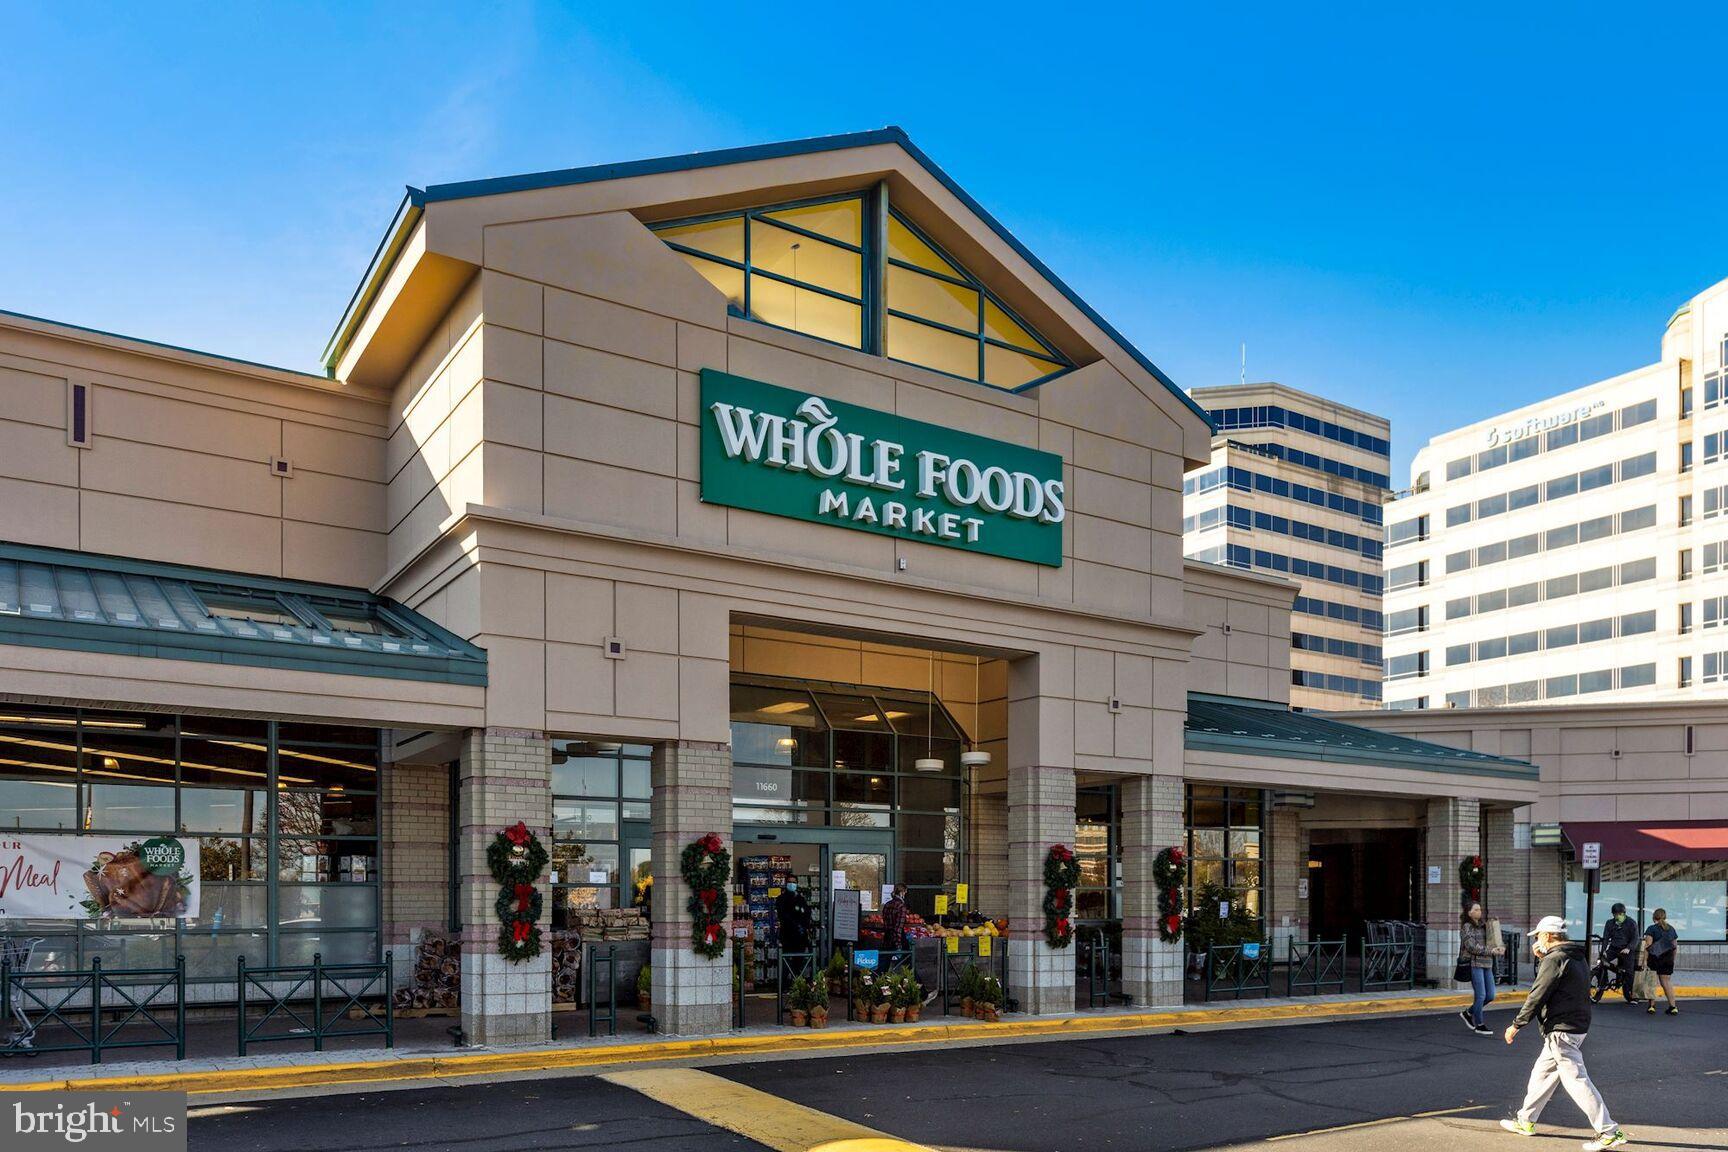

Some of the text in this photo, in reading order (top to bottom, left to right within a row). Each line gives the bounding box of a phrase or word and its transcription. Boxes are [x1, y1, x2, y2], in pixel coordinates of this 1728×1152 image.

[710, 397, 1066, 523] WHOLE FOODS
[817, 488, 985, 543] MARKET
[755, 782, 778, 792] 11660
[144, 845, 181, 855] WHOLE
[146, 854, 180, 864] FOODS
